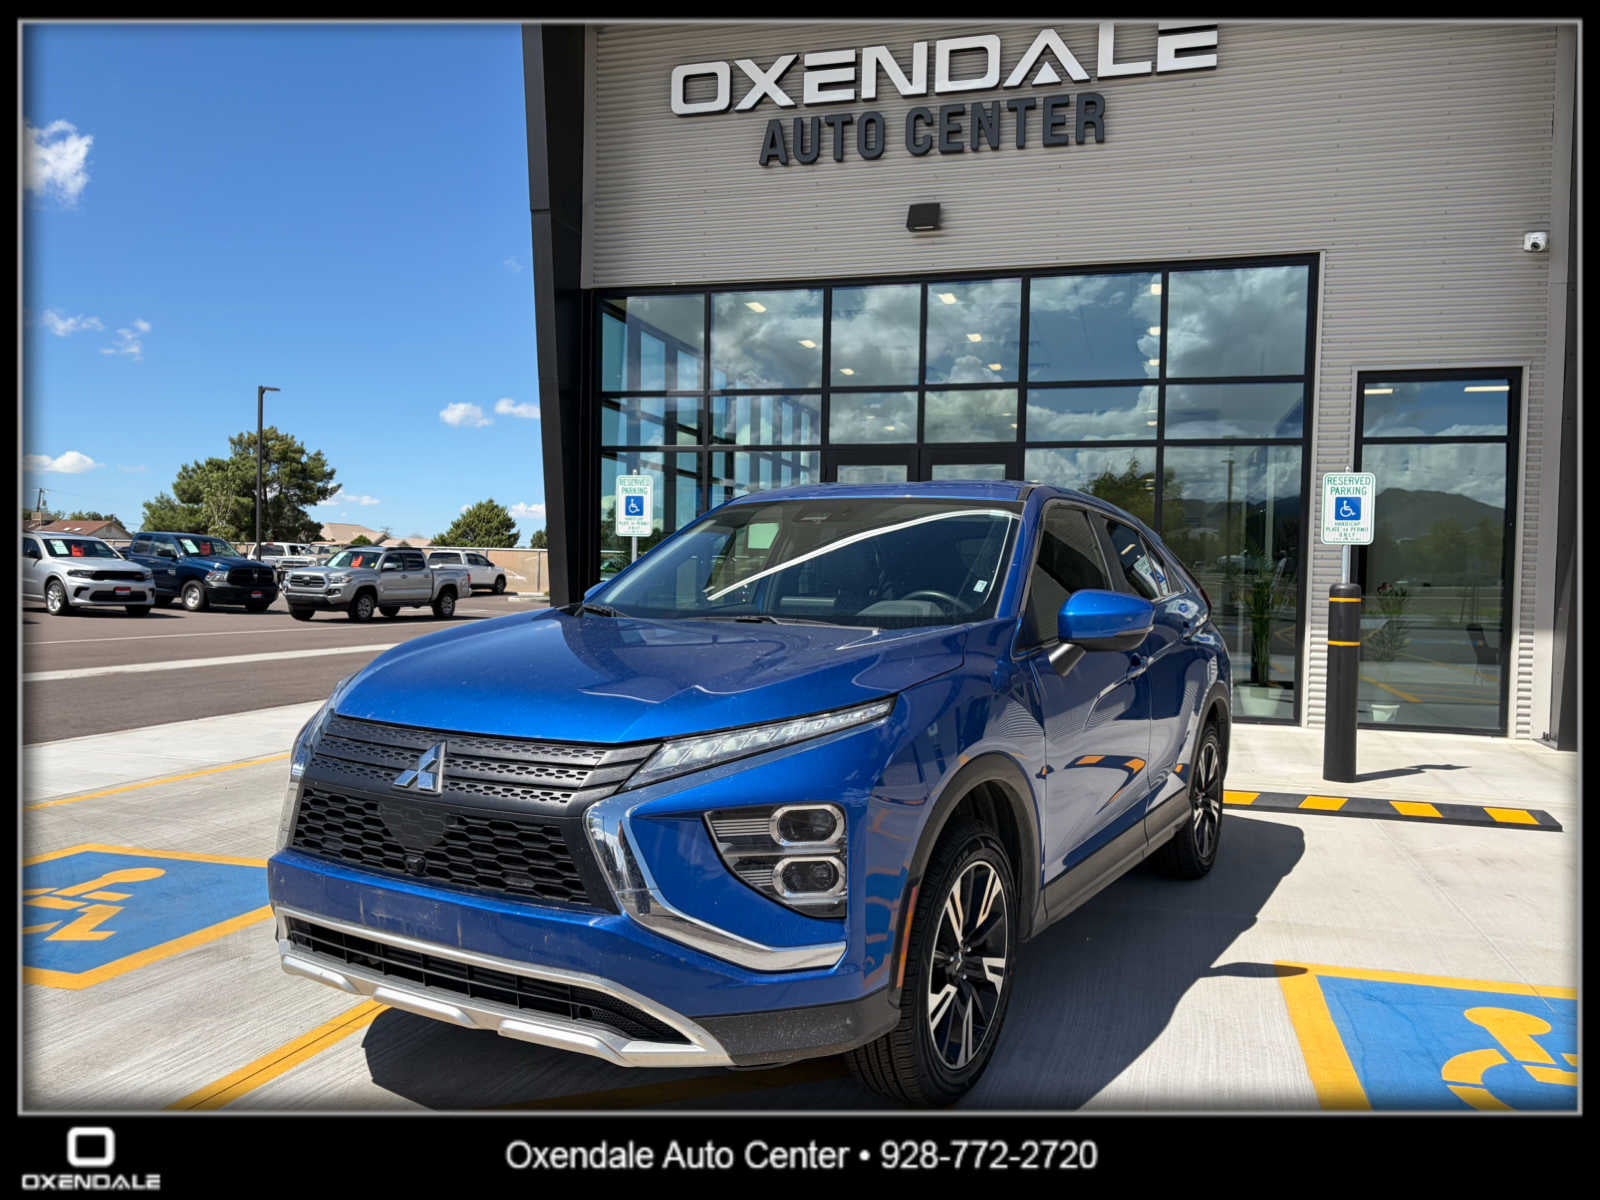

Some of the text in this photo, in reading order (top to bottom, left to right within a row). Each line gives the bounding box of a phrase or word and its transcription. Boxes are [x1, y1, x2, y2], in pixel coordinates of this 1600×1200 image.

[671, 23, 1218, 116] OXENDALE
[759, 92, 1106, 166] AUTO CENTER
[1327, 476, 1371, 486] RESERVED
[621, 487, 649, 495] PARKING
[1330, 486, 1367, 496] PARKING
